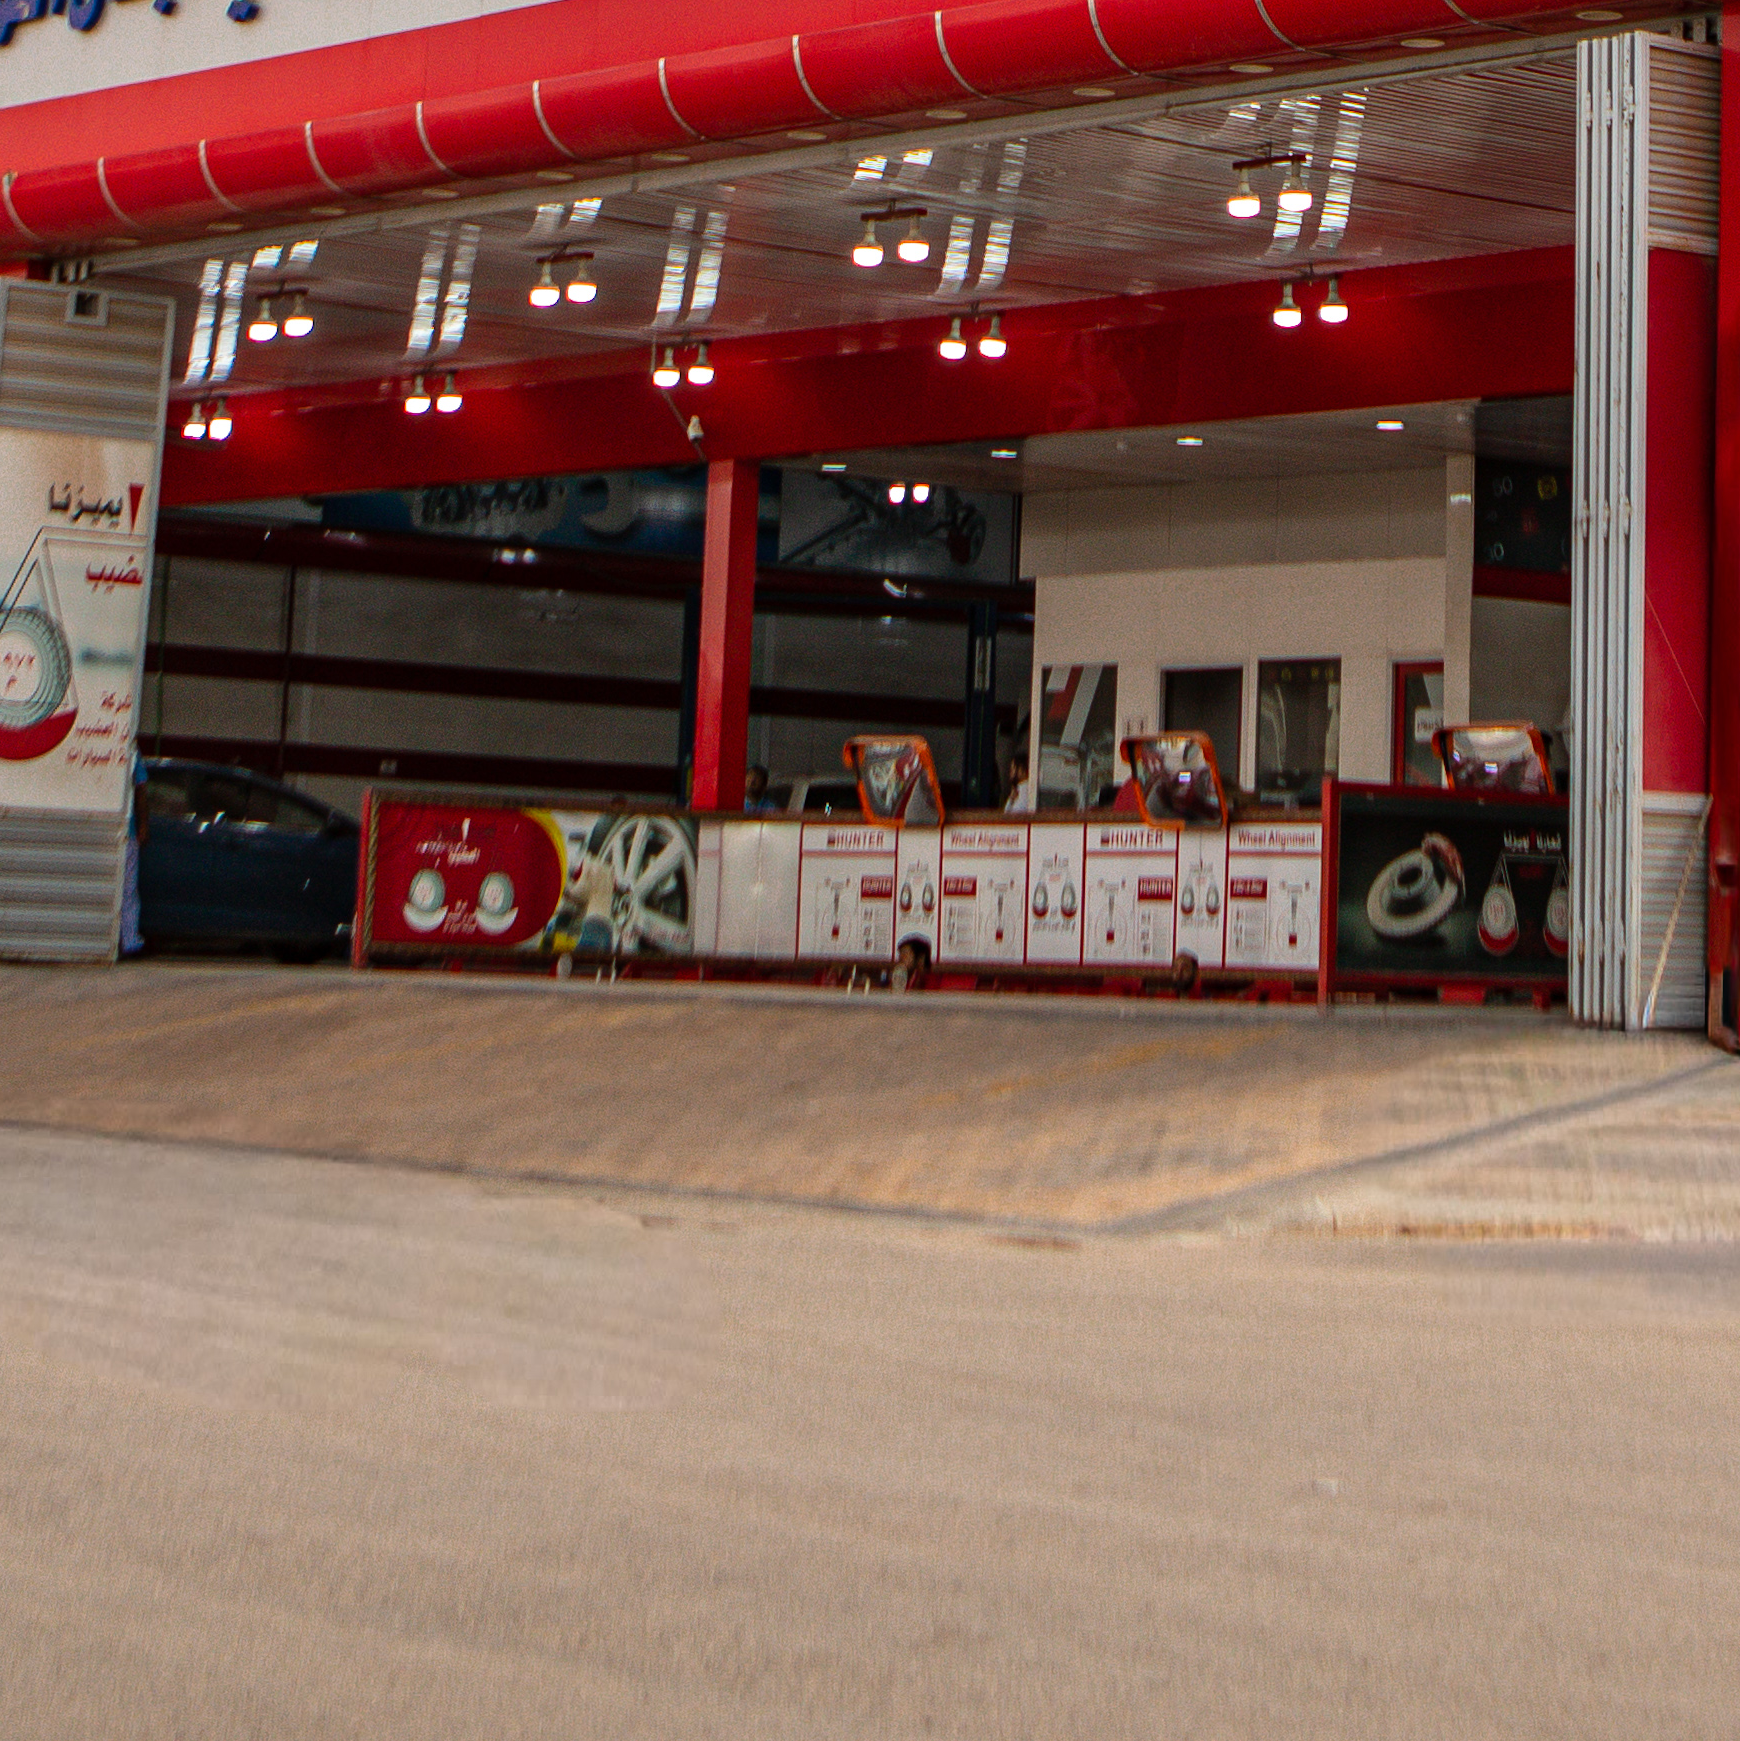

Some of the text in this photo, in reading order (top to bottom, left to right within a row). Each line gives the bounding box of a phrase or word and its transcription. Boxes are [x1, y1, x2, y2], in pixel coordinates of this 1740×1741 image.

[49, 482, 123, 528] يميزنا
[836, 830, 885, 847] HUNTER
[1111, 828, 1164, 847] HUNTER
